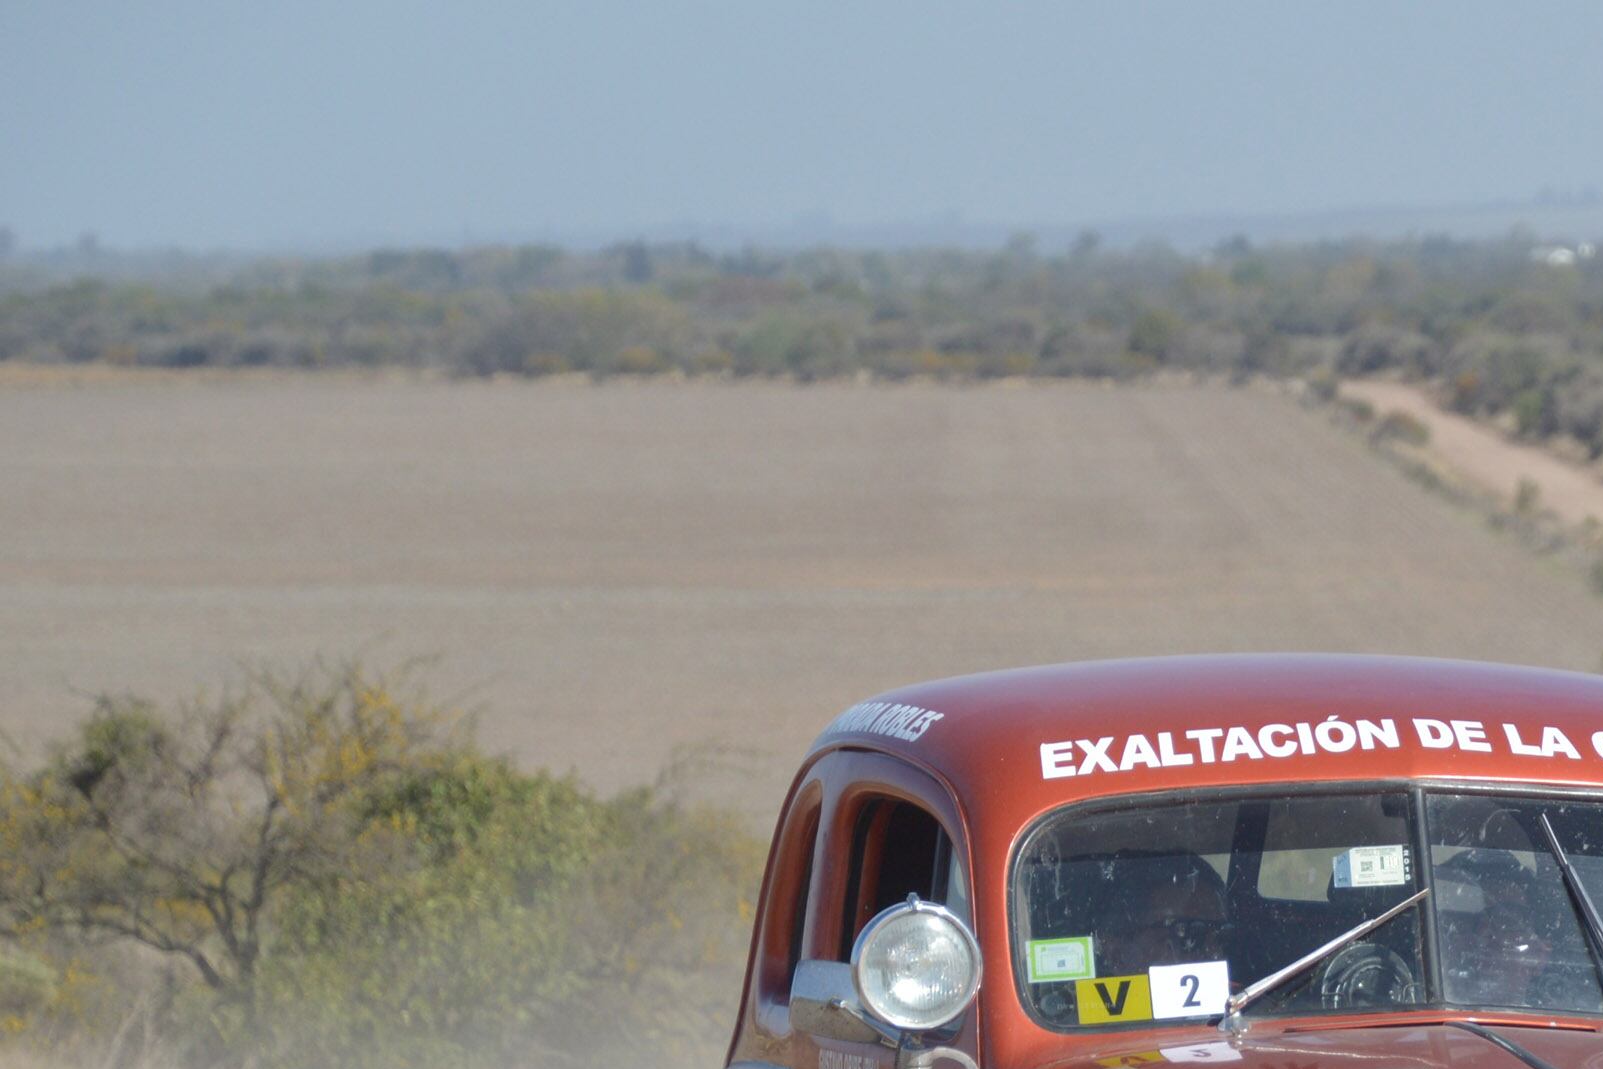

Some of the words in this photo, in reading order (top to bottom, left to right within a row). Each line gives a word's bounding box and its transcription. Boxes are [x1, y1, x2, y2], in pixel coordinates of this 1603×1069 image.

[1040, 715, 1400, 779] EXALTACIÓN
[1412, 718, 1492, 752] DE
[1502, 723, 1582, 760] LA
[1094, 980, 1132, 1016] V
[1179, 974, 1201, 1008] 2
